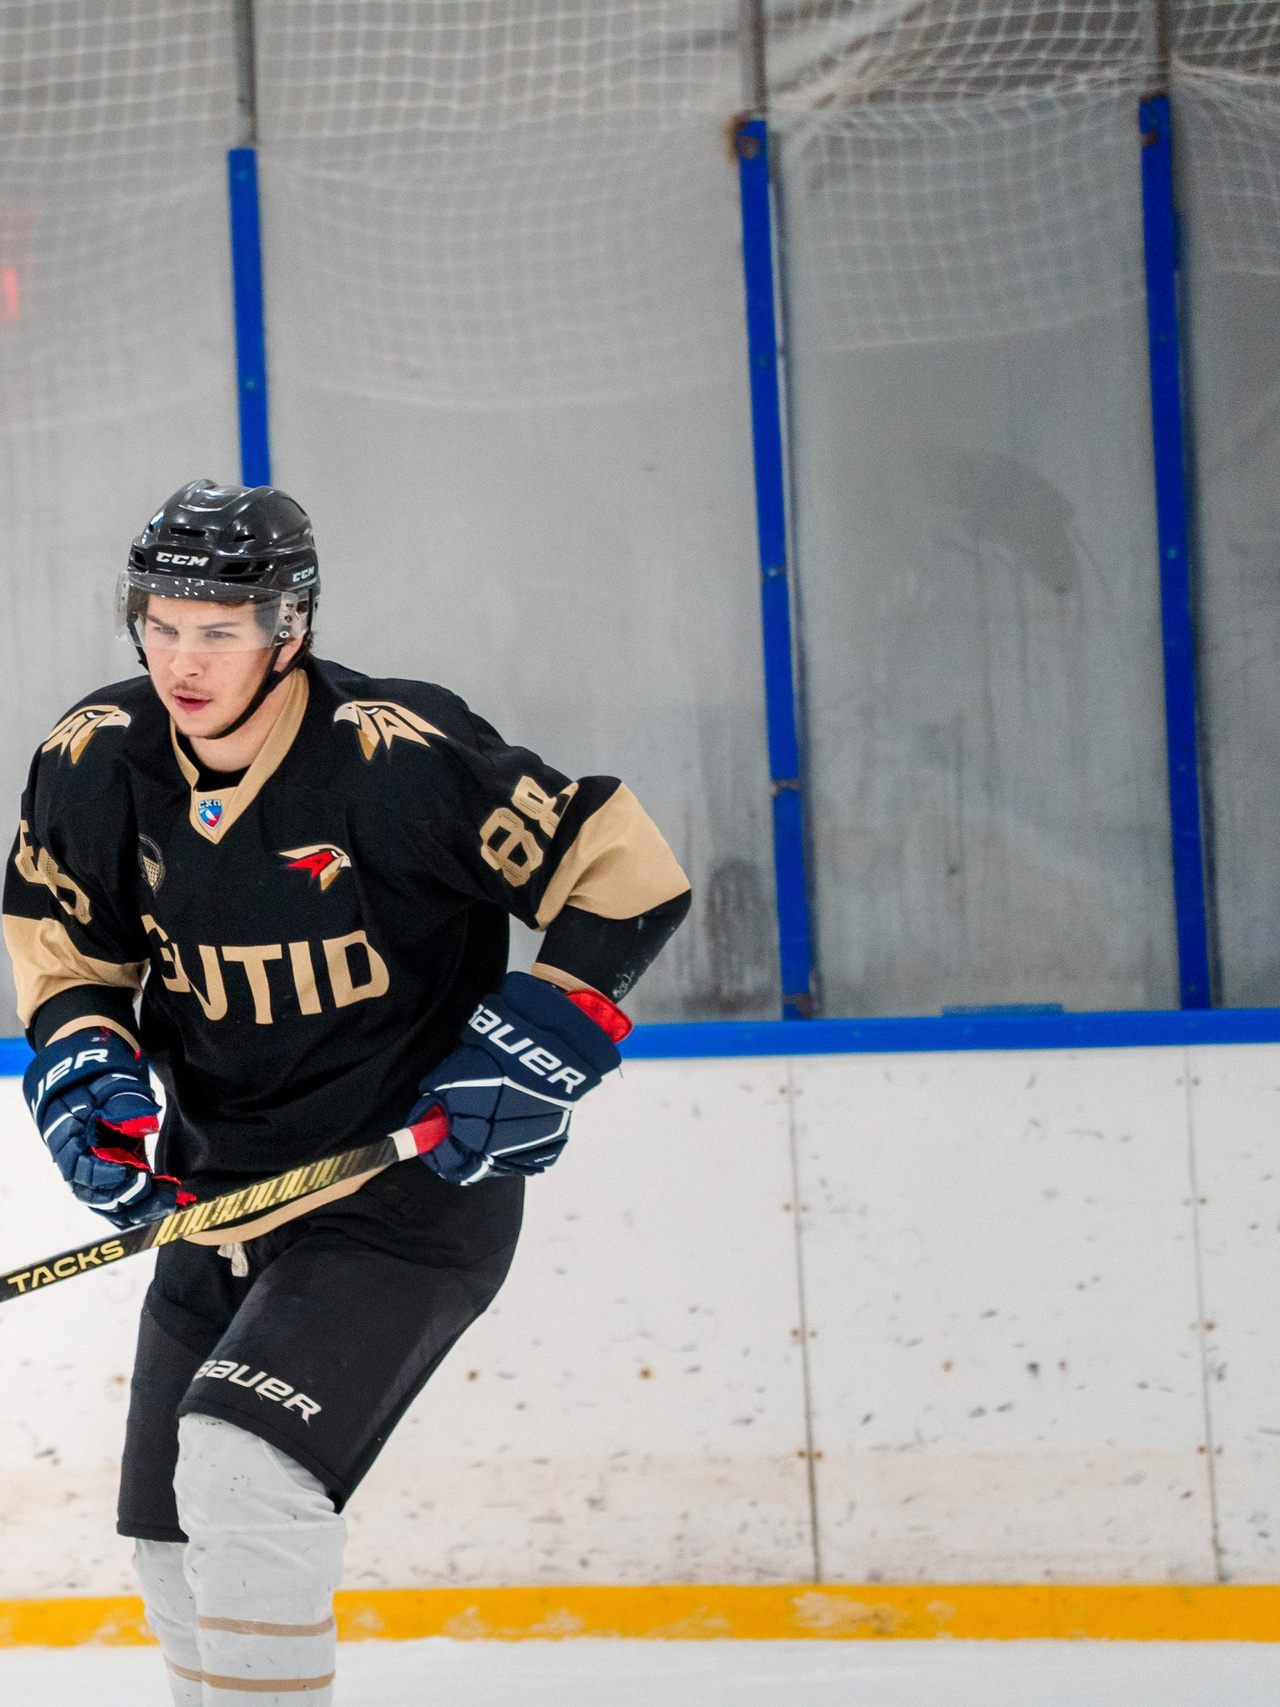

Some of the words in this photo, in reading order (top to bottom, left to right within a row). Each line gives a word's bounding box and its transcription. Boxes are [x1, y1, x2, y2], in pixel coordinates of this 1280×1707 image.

[155, 552, 210, 568] CCM
[292, 566, 315, 583] CCM
[468, 1004, 587, 1095] AUER
[7, 1239, 125, 1293] TACKS
